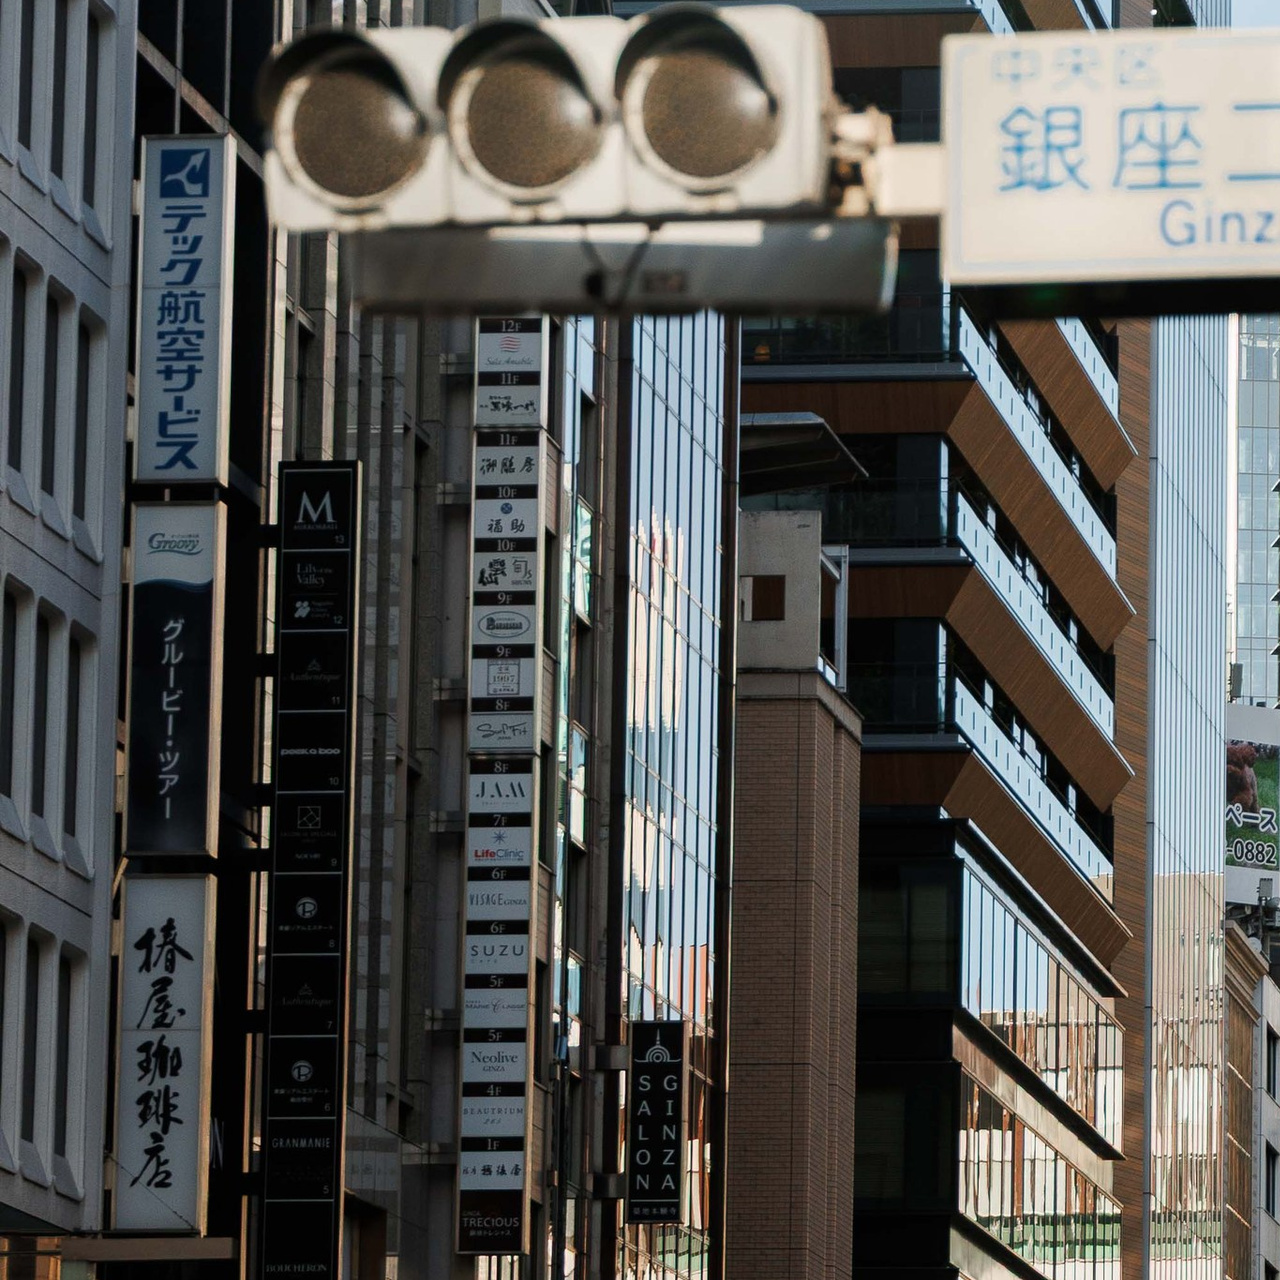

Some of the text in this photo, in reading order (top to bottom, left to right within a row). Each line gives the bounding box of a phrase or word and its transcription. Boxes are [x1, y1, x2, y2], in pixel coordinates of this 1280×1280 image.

[992, 45, 1161, 94] 中央区
[154, 205, 207, 470] テック航空サービス
[497, 486, 517, 498] 10F
[295, 490, 338, 523] M
[488, 519, 525, 533] 福助
[148, 531, 200, 554] Groovy
[496, 539, 516, 551] 10F
[497, 592, 513, 604] 9F
[496, 646, 512, 657] 9F
[495, 699, 510, 710] 8F
[158, 620, 185, 819] グルービー・ツアー
[494, 761, 509, 773] 8F
[493, 814, 507, 826] 7F
[1226, 803, 1277, 833] ペース
[491, 868, 507, 879] 6F
[490, 922, 506, 934] 6F
[471, 945, 524, 957] SUZU
[489, 975, 504, 987] 5F
[488, 1030, 502, 1042] 5F
[130, 917, 194, 1189] 椿屋珈琲店
[471, 1051, 518, 1064] Neolive
[486, 1084, 502, 1096] 4F
[463, 1107, 523, 1115] BEAUTRIUM
[635, 1075, 651, 1190] SALON
[661, 1075, 678, 1190] GINZA
[487, 1138, 500, 1150] 1F
[462, 1217, 519, 1227] TRECIOUS
[266, 1263, 327, 1273] BOUCHERON
